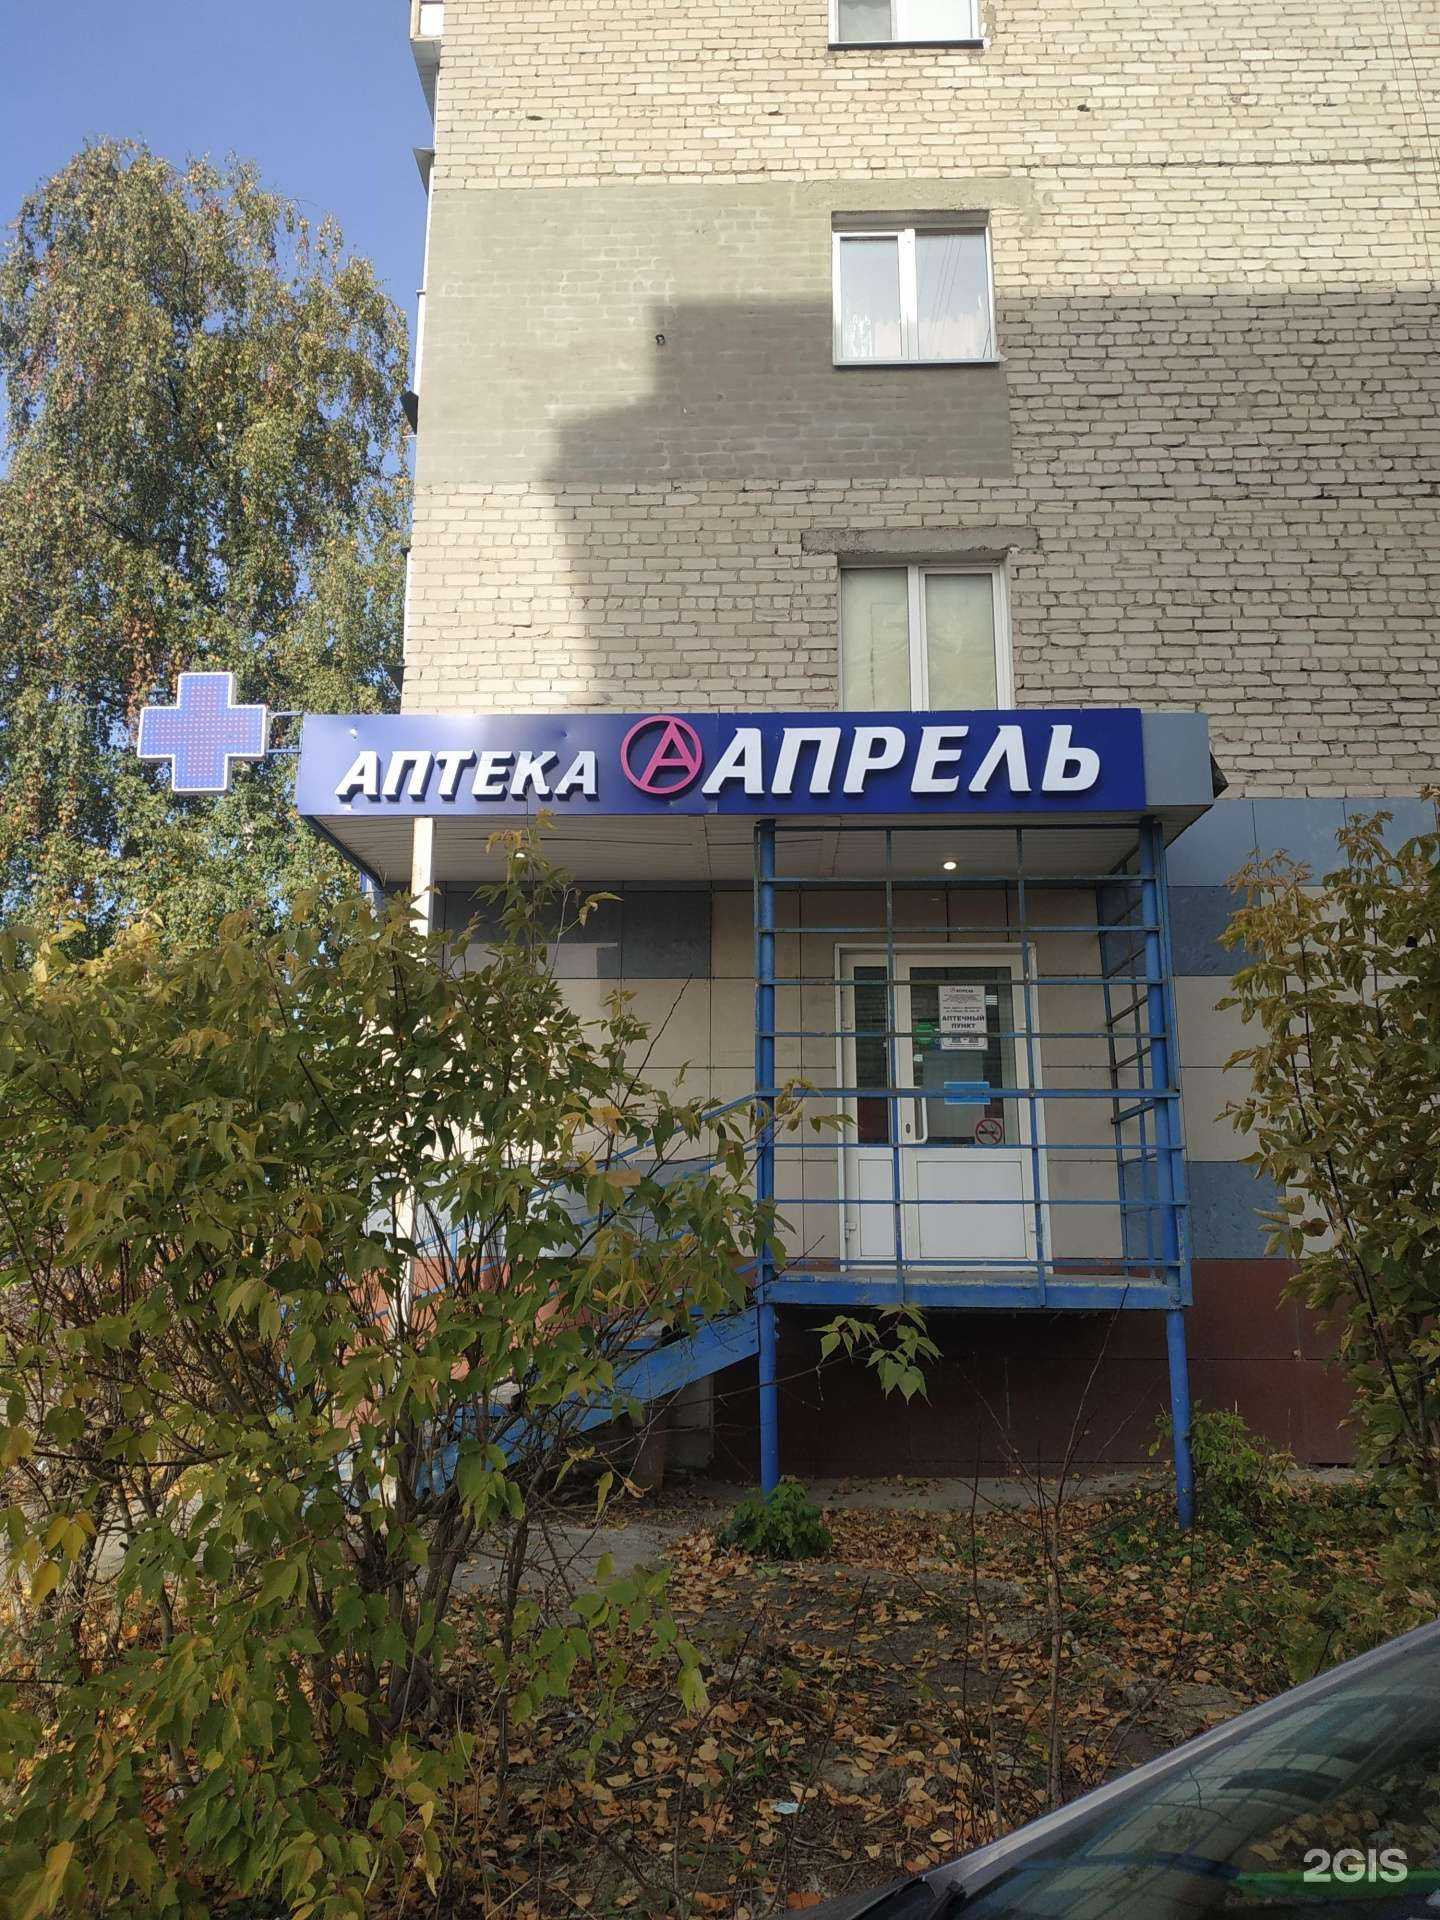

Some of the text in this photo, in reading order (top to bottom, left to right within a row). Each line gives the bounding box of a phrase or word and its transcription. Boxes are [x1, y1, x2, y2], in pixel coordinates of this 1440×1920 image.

[334, 750, 599, 801] АПТЕКА
[701, 724, 1101, 796] АПРЕЛЬ
[942, 1014, 985, 1022] АПТЕЧНЫЙ
